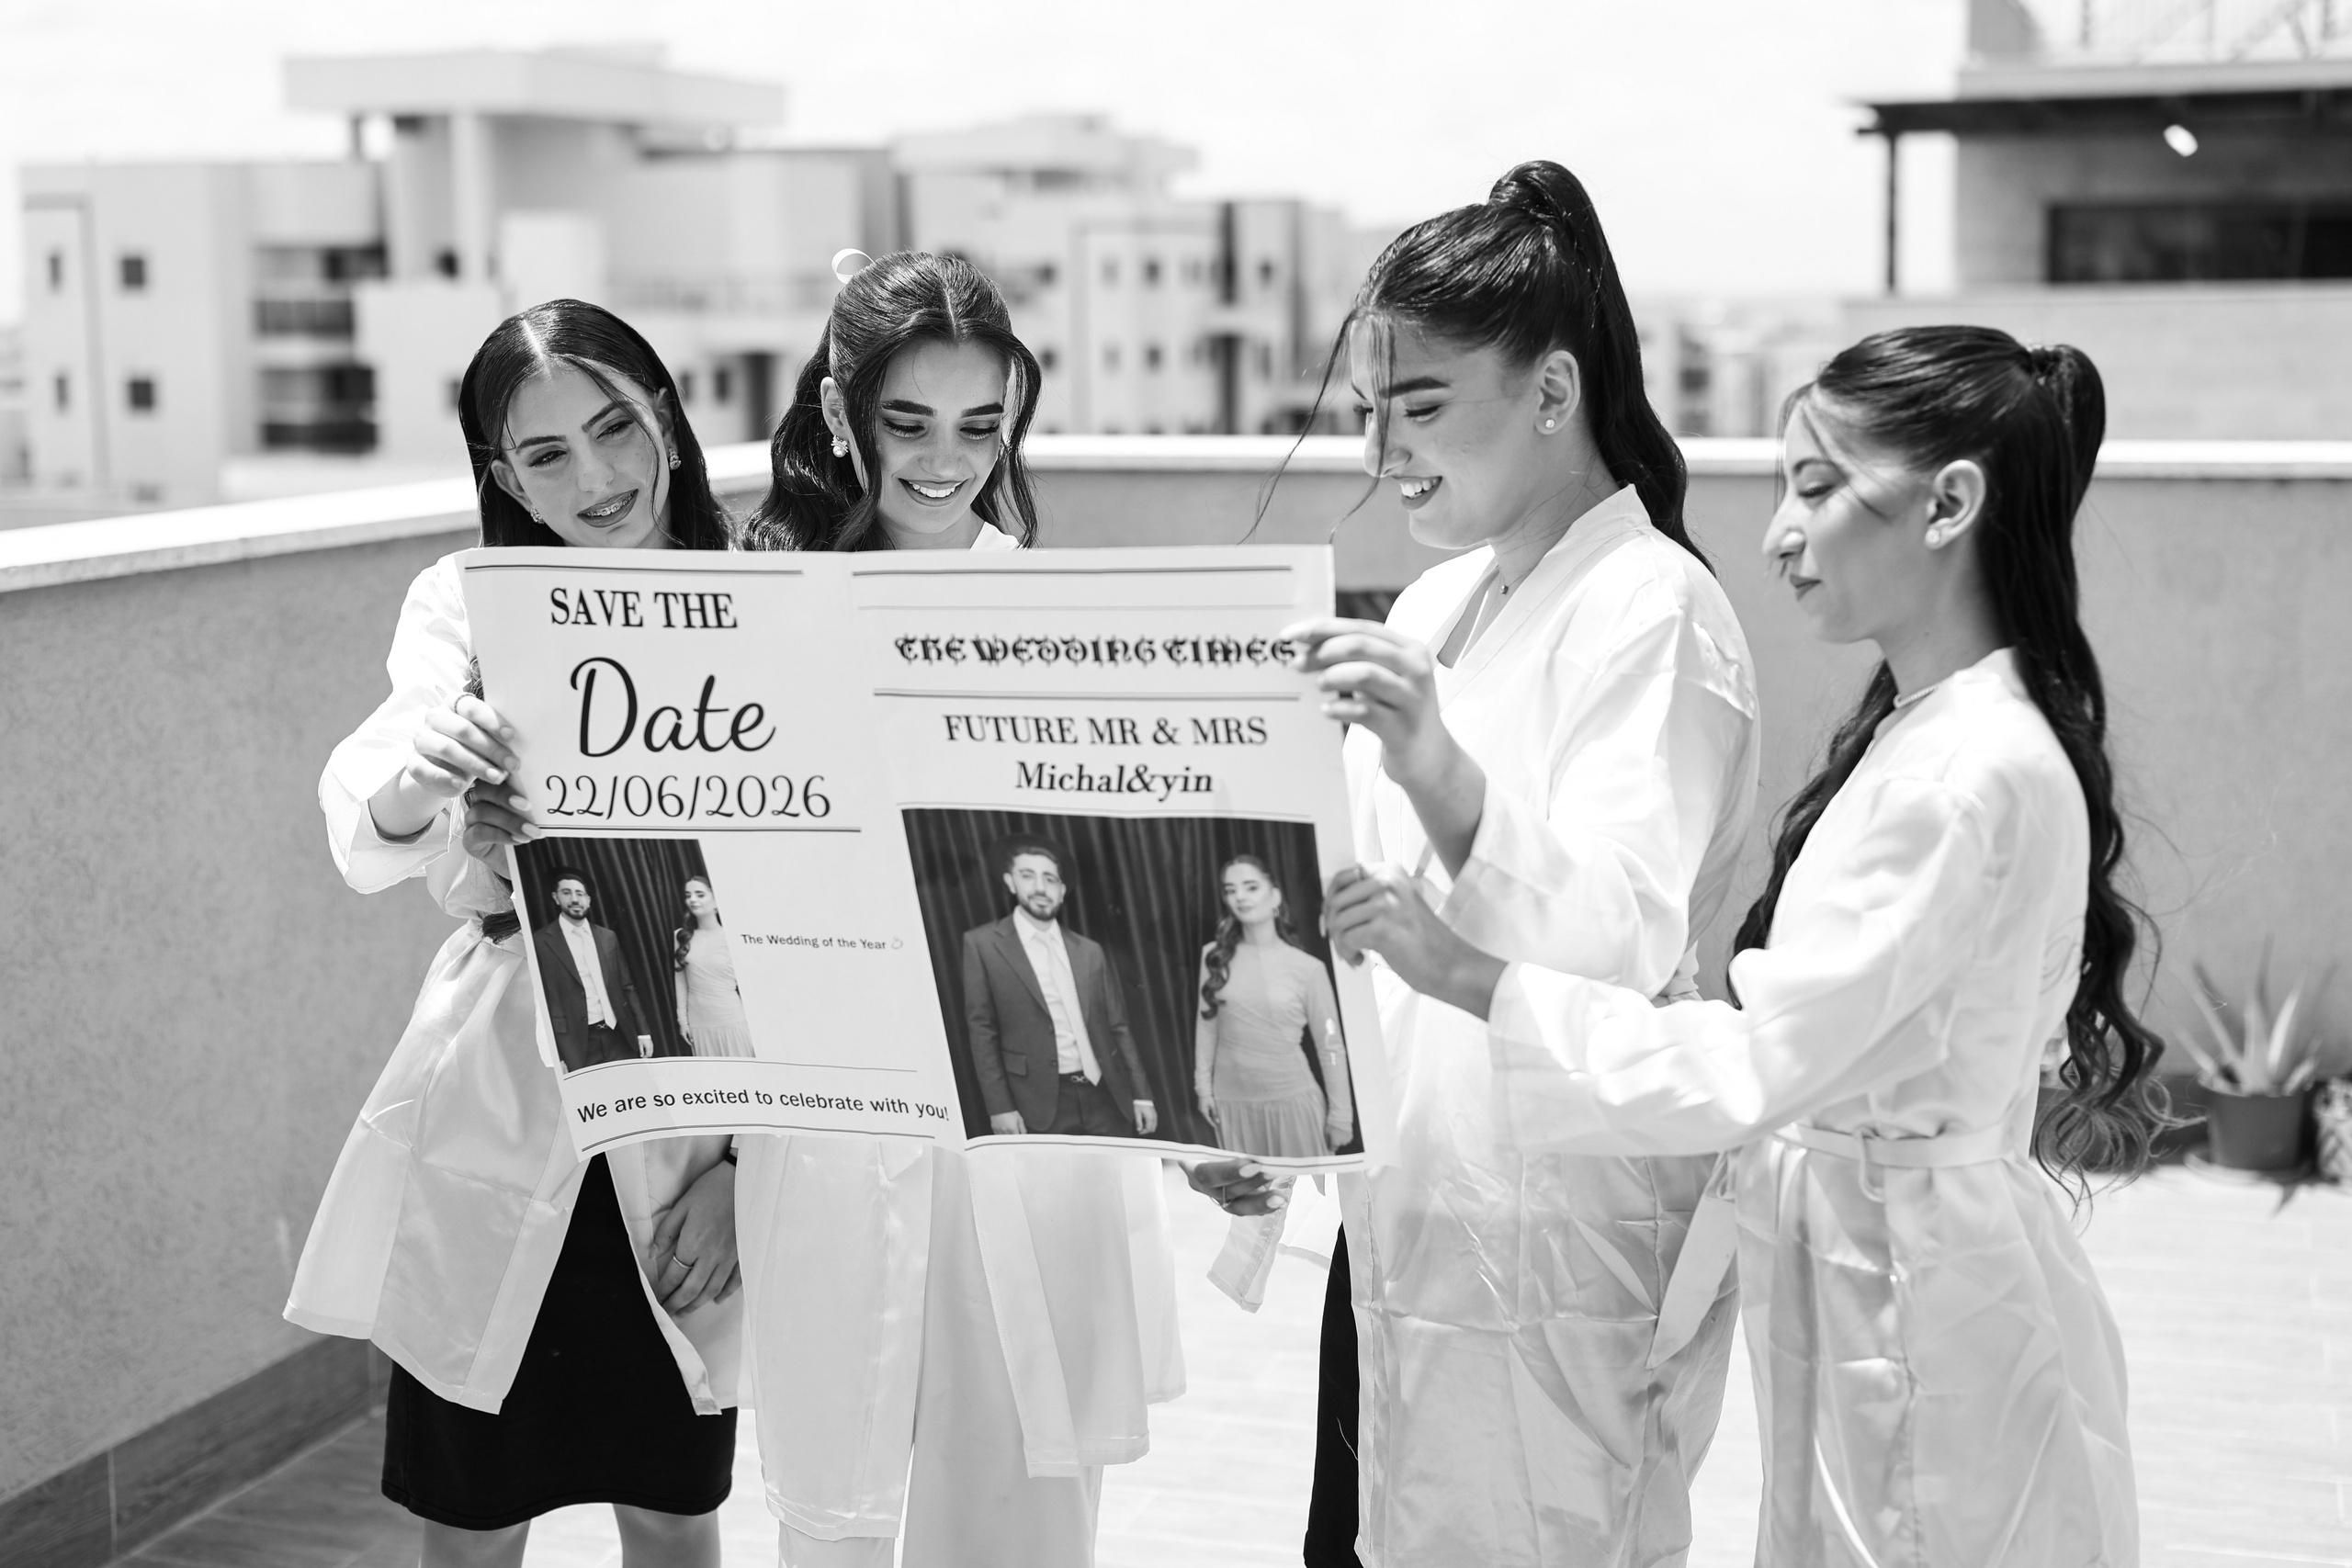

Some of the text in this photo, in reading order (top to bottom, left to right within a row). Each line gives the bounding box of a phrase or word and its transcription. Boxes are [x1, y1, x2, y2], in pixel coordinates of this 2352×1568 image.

[550, 588, 738, 629] SAVE THE
[570, 657, 776, 758] Date
[944, 715, 1269, 746] FUTURE MR & MRS
[545, 774, 831, 821] 22/06/2026
[1015, 761, 1213, 802] Michal&yin
[741, 933, 887, 950] The Wedding of the Year
[577, 1089, 950, 1123] We are so excited to celebrate with you!
